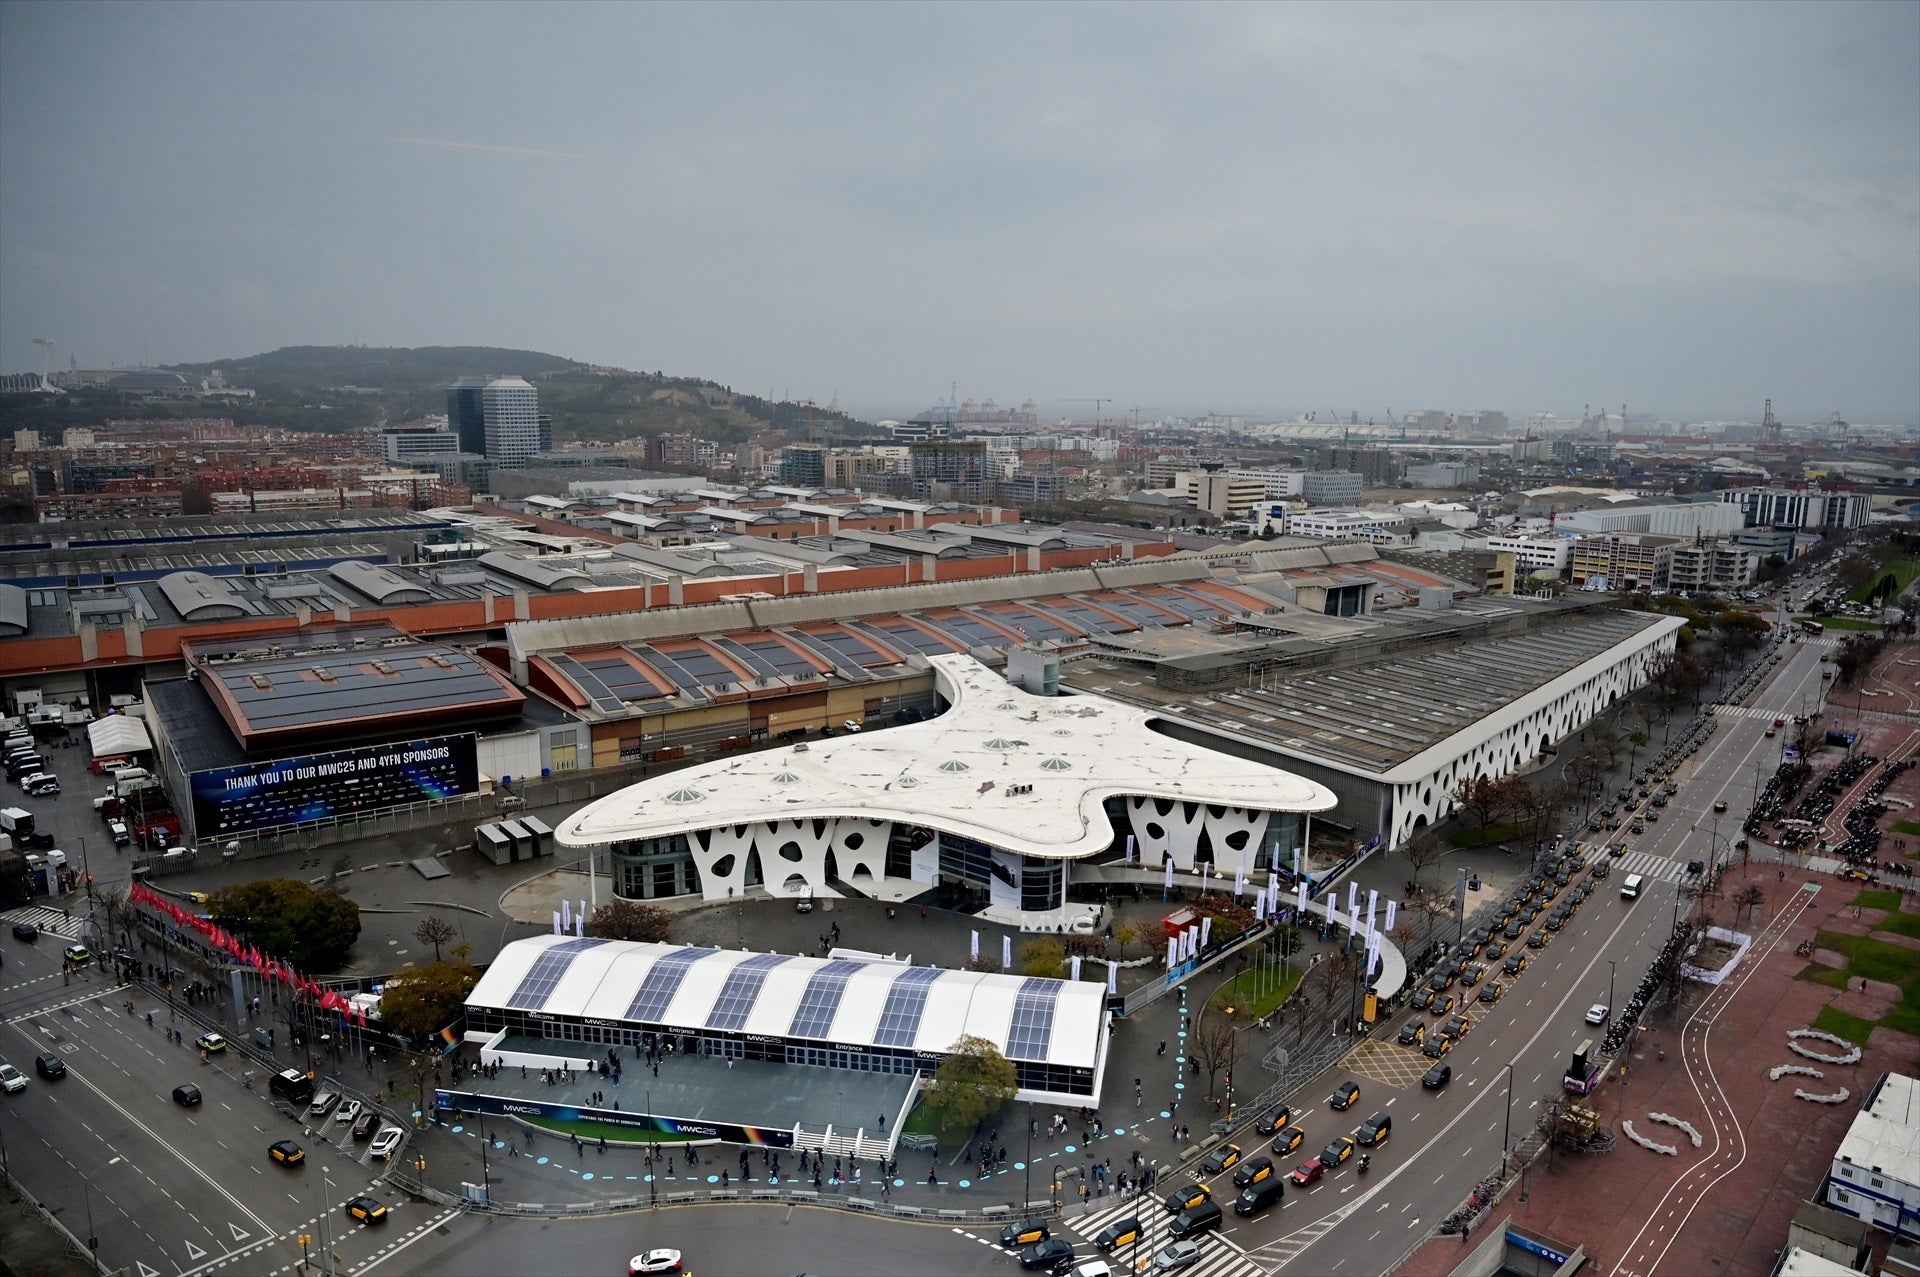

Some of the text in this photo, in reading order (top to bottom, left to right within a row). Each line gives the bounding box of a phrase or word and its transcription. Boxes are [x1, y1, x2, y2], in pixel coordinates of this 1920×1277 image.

[225, 746, 450, 790] THANK YOU TO OUR MWC25 AND 4YFN SPONSORS
[1020, 914, 1094, 934] MWC
[528, 1012, 555, 1021] Welcome
[584, 1018, 618, 1027] MWC25
[669, 1026, 696, 1035] Entrance
[747, 1034, 782, 1044] MWC25
[835, 1043, 863, 1052] Entrance
[503, 1104, 541, 1115] MWC25
[677, 1124, 717, 1135] MWC25
